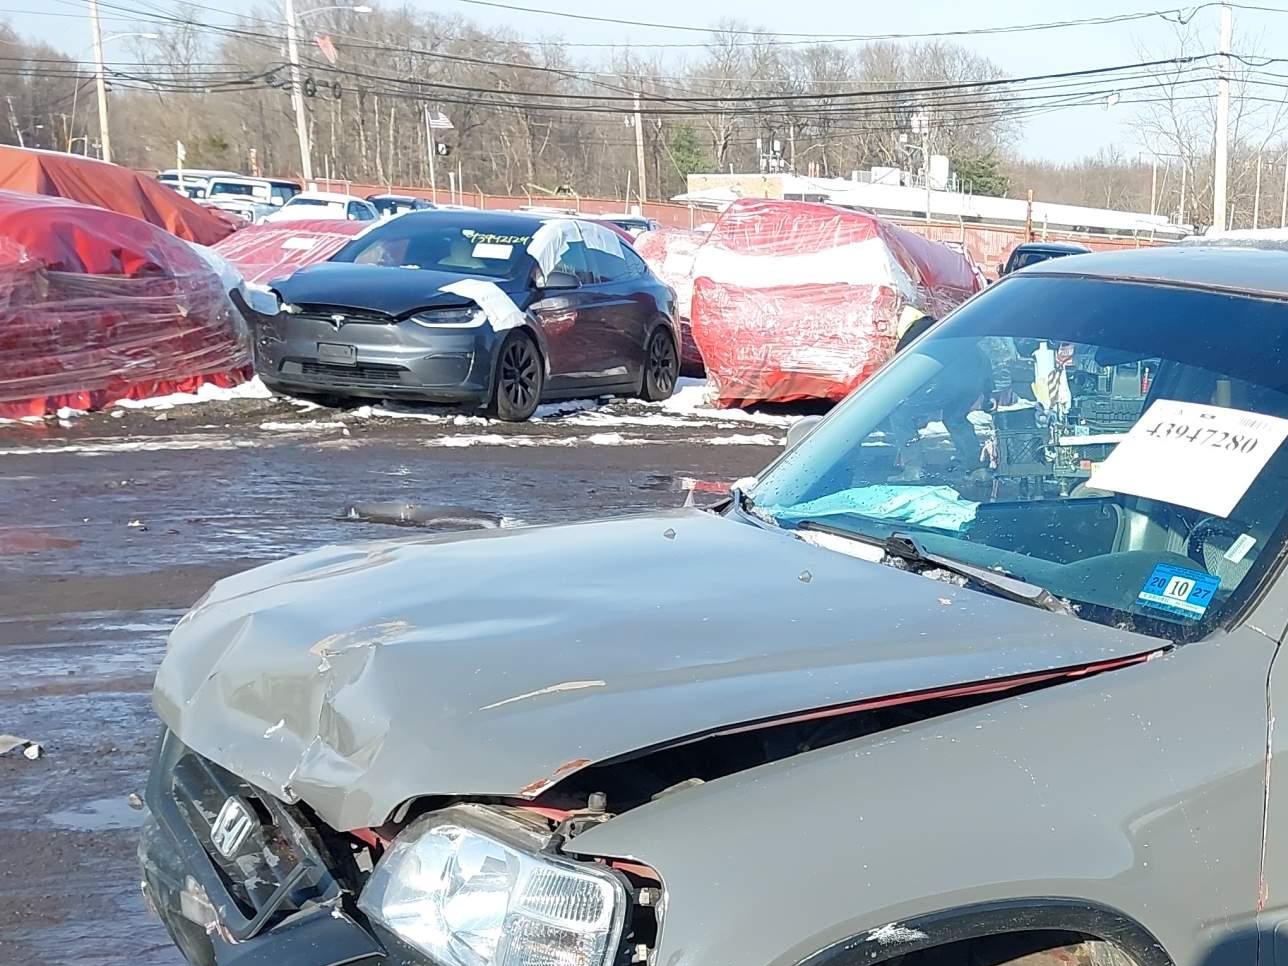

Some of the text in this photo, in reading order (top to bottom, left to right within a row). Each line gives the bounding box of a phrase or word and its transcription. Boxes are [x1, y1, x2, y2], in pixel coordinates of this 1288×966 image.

[1146, 421, 1259, 454] 43947280
[1150, 576, 1211, 599] 20 10 27
